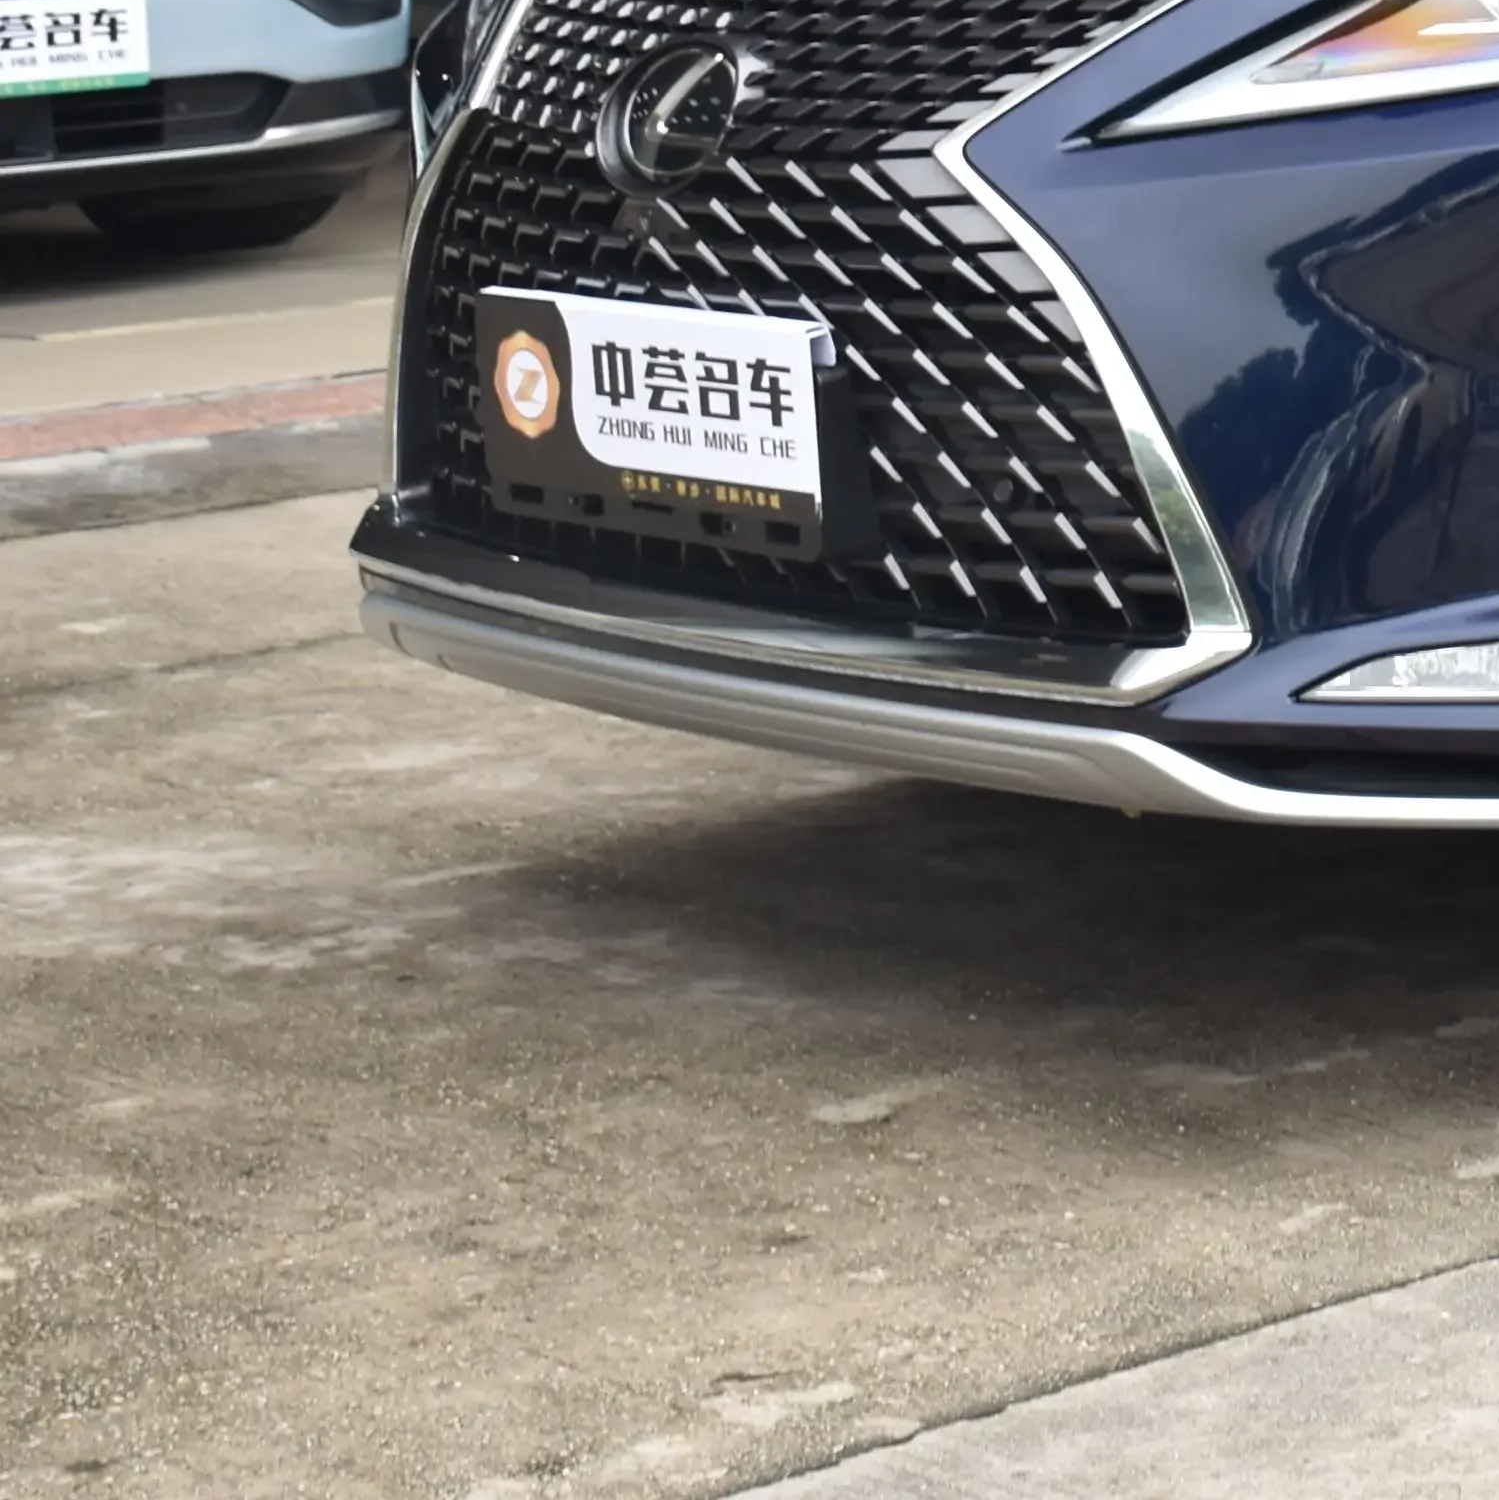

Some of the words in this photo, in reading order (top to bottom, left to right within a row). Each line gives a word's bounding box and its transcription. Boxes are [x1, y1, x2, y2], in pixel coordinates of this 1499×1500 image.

[591, 340, 794, 428] 中荟名车
[598, 415, 656, 442] ZHONG
[663, 424, 692, 448] HUI
[704, 430, 748, 454] MING
[760, 437, 797, 460] CHE
